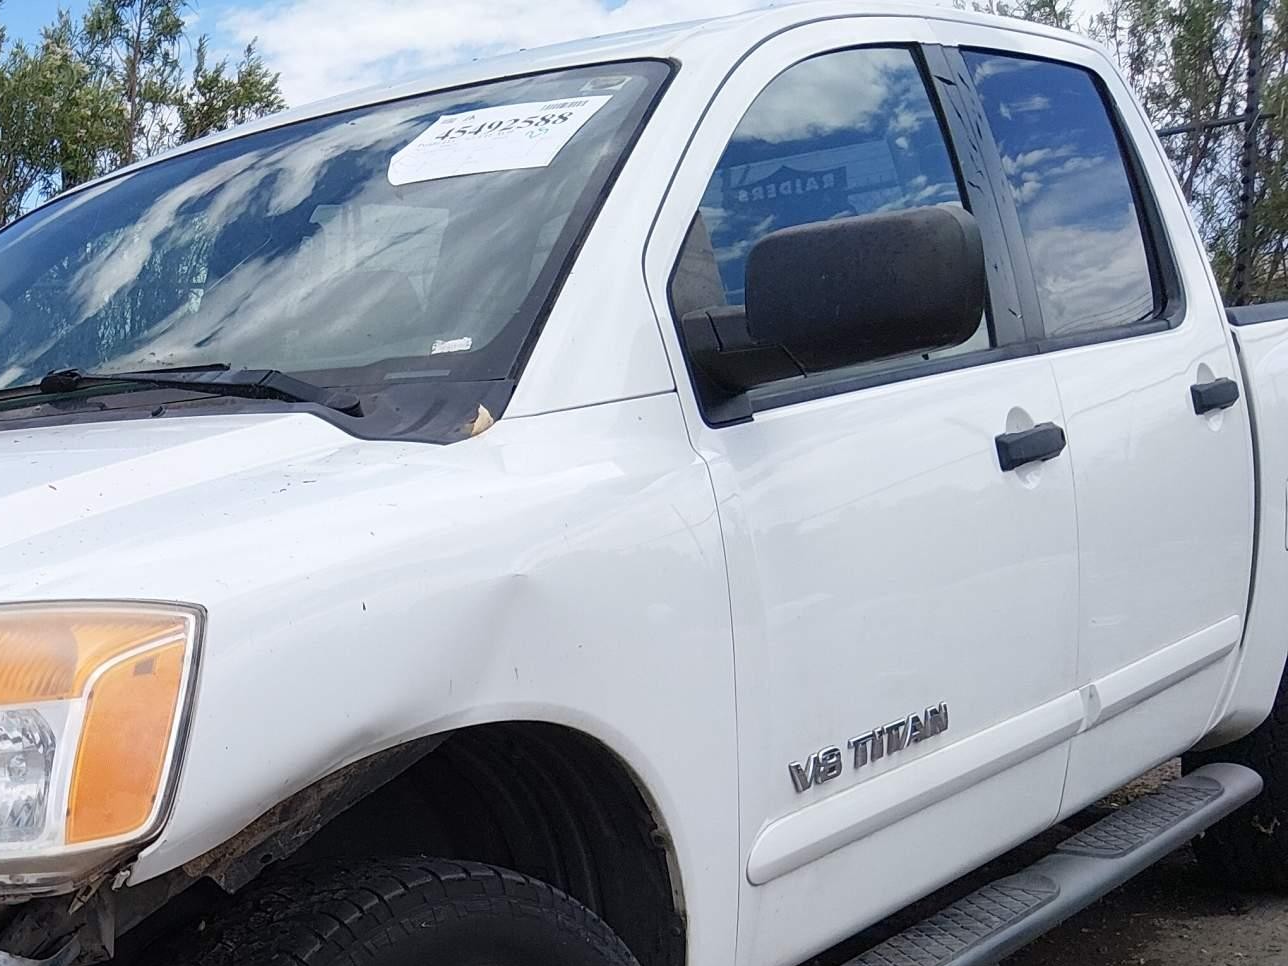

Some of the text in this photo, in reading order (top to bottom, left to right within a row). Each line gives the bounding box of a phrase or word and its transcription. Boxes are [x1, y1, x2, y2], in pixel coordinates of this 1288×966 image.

[435, 112, 573, 140] 45492588
[788, 700, 949, 793] V8 TITAN
